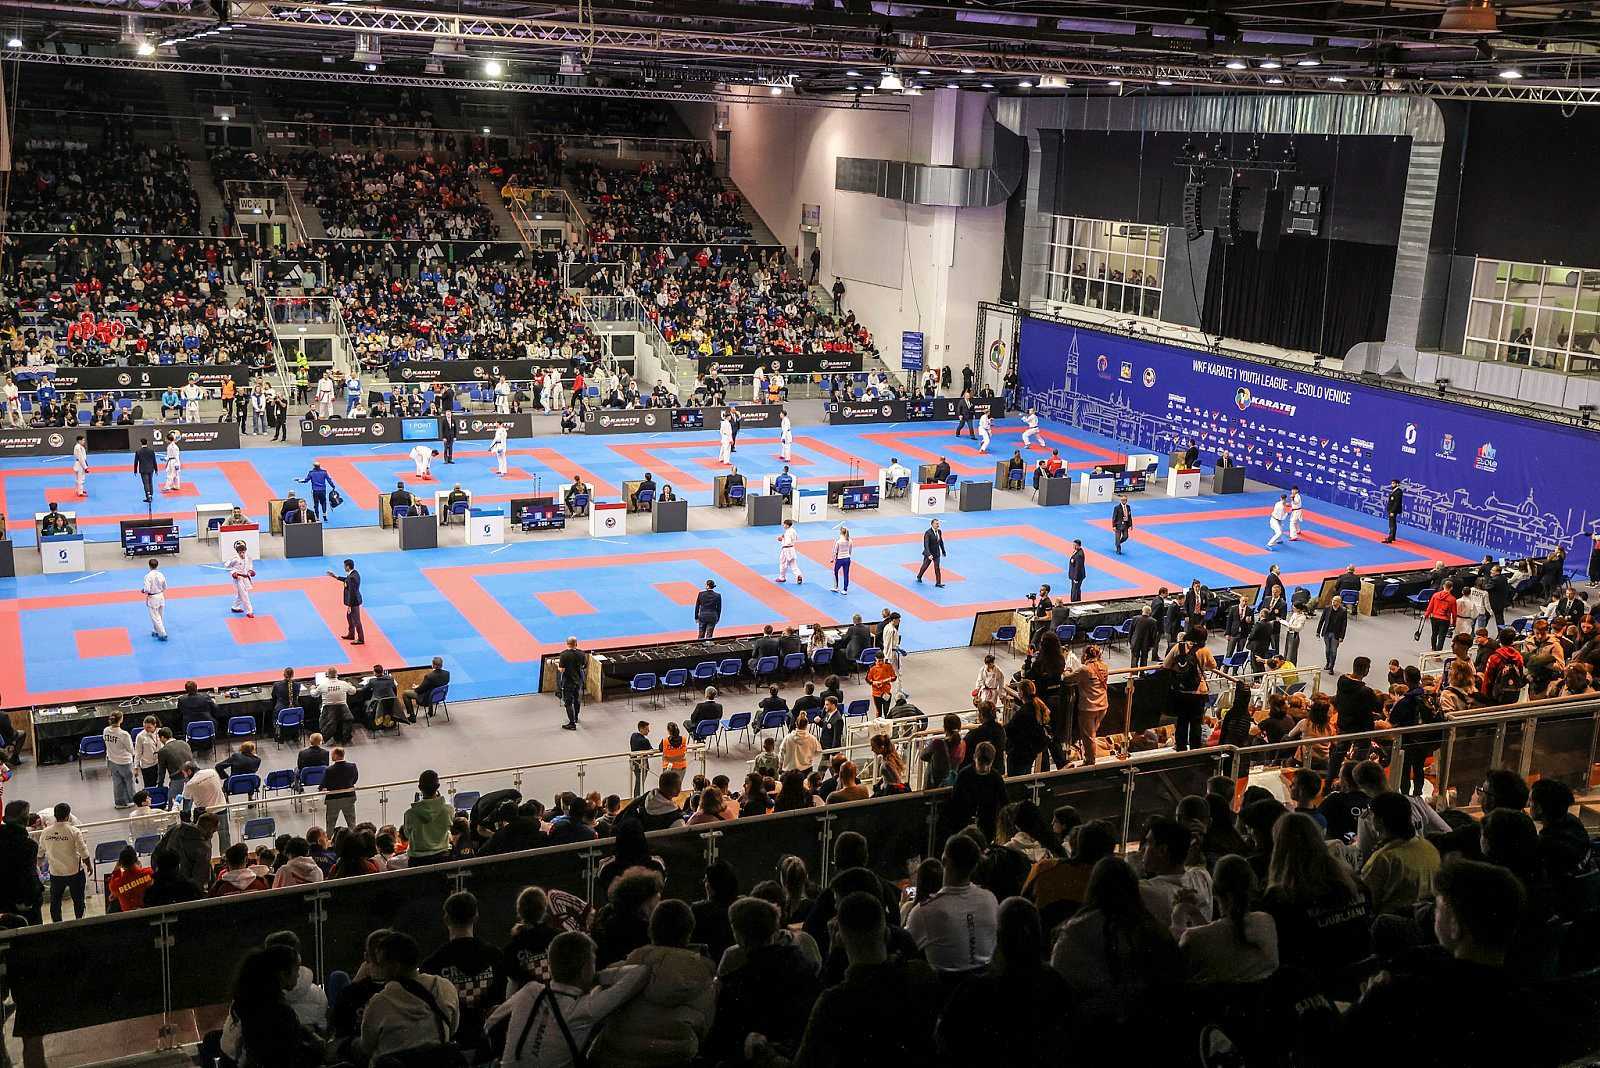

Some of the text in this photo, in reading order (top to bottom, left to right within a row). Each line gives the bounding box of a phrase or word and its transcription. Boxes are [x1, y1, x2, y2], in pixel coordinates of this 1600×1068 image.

[241, 200, 252, 208] WC
[1192, 359, 1207, 373] WKF
[1207, 362, 1233, 379] KARATE
[1233, 368, 1237, 379] 1
[1239, 370, 1261, 384] YOUTH
[1261, 374, 1288, 391] LEAGUE
[1294, 382, 1323, 398] JESOLO
[1324, 388, 1352, 405] VENICE
[119, 874, 152, 894] BELGIUM
